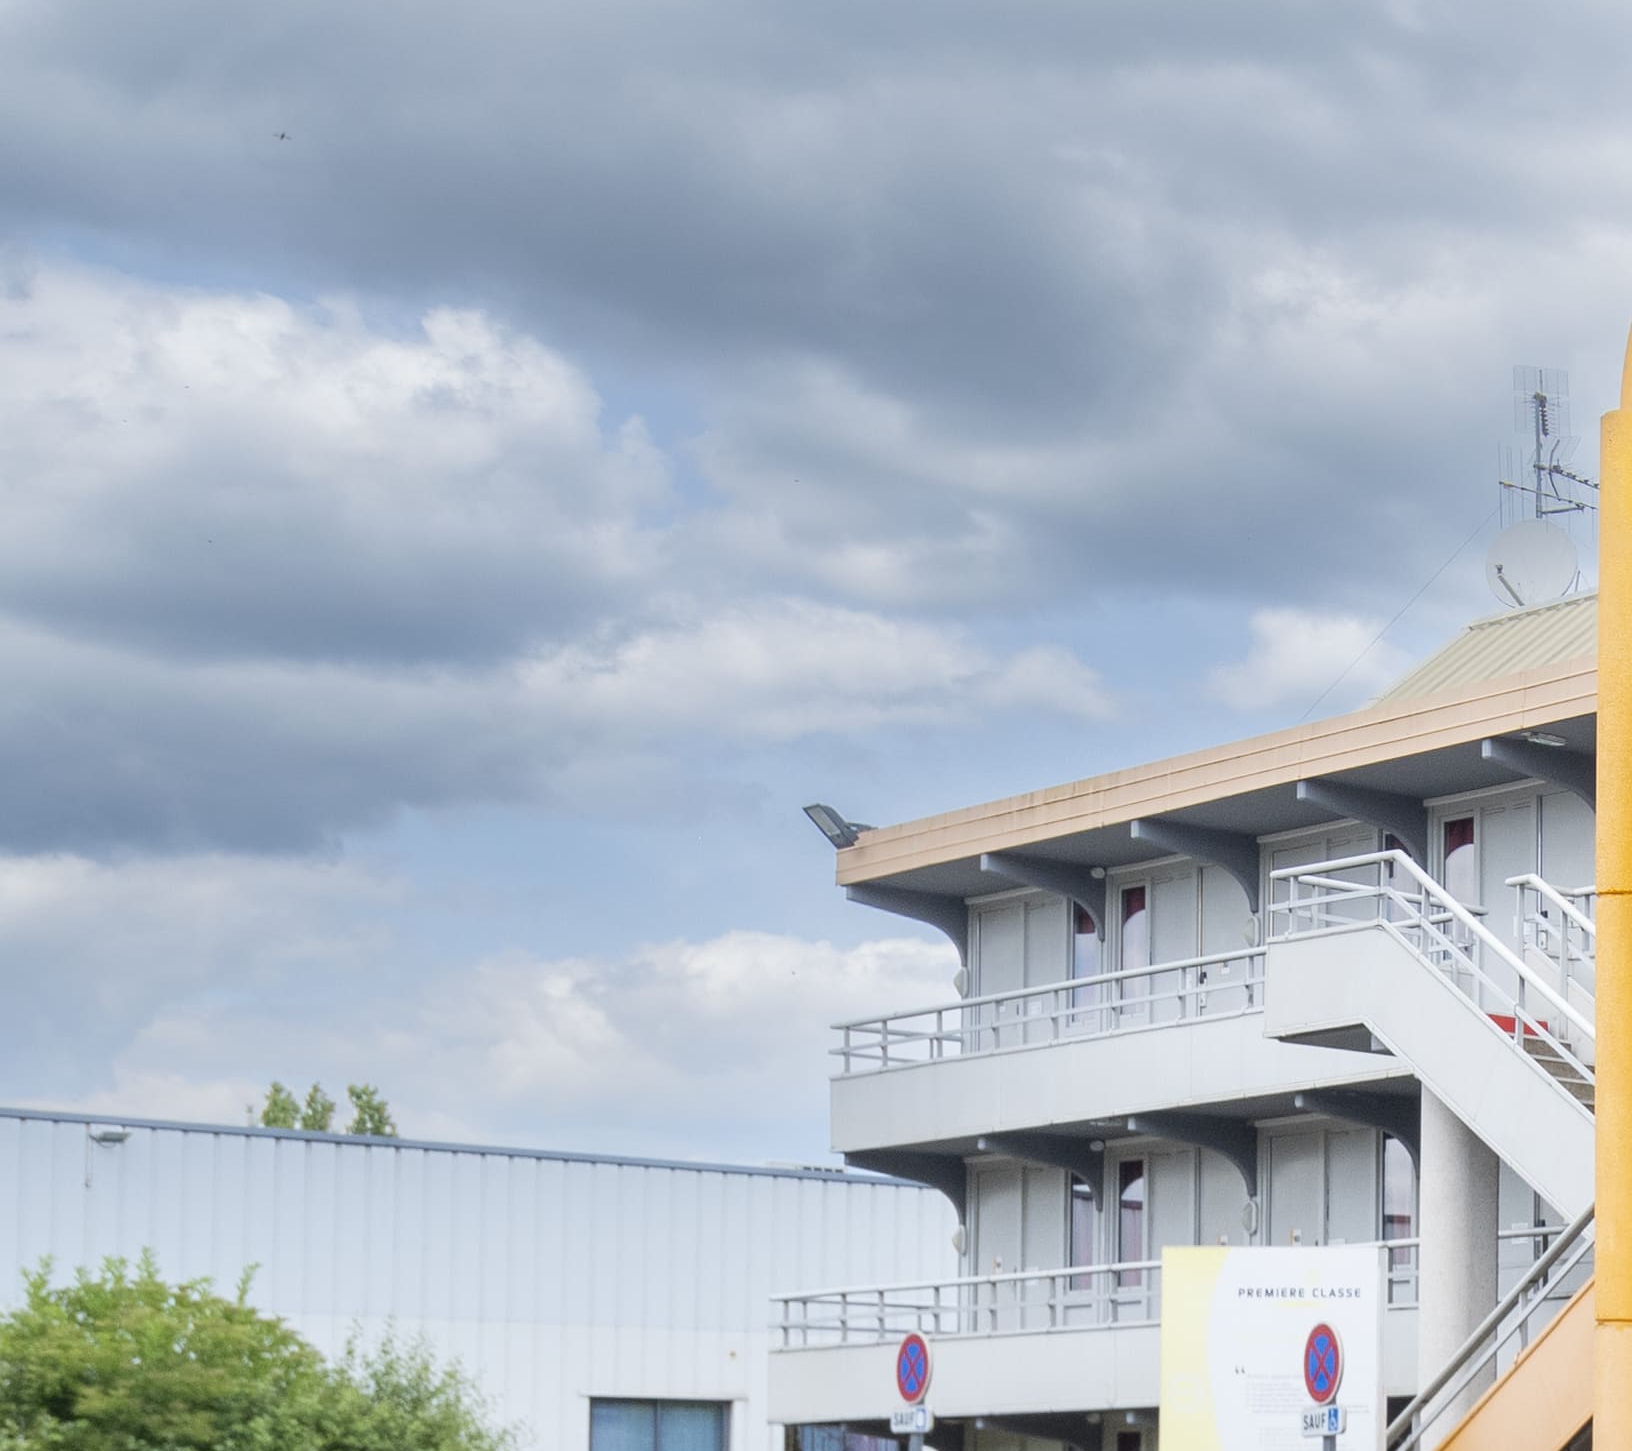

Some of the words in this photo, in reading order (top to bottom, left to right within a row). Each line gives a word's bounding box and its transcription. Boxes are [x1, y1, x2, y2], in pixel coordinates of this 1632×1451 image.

[1237, 1287, 1305, 1299] PREMIERE
[1311, 1287, 1361, 1299] CLASSE
[1303, 1412, 1327, 1431] SAUF
